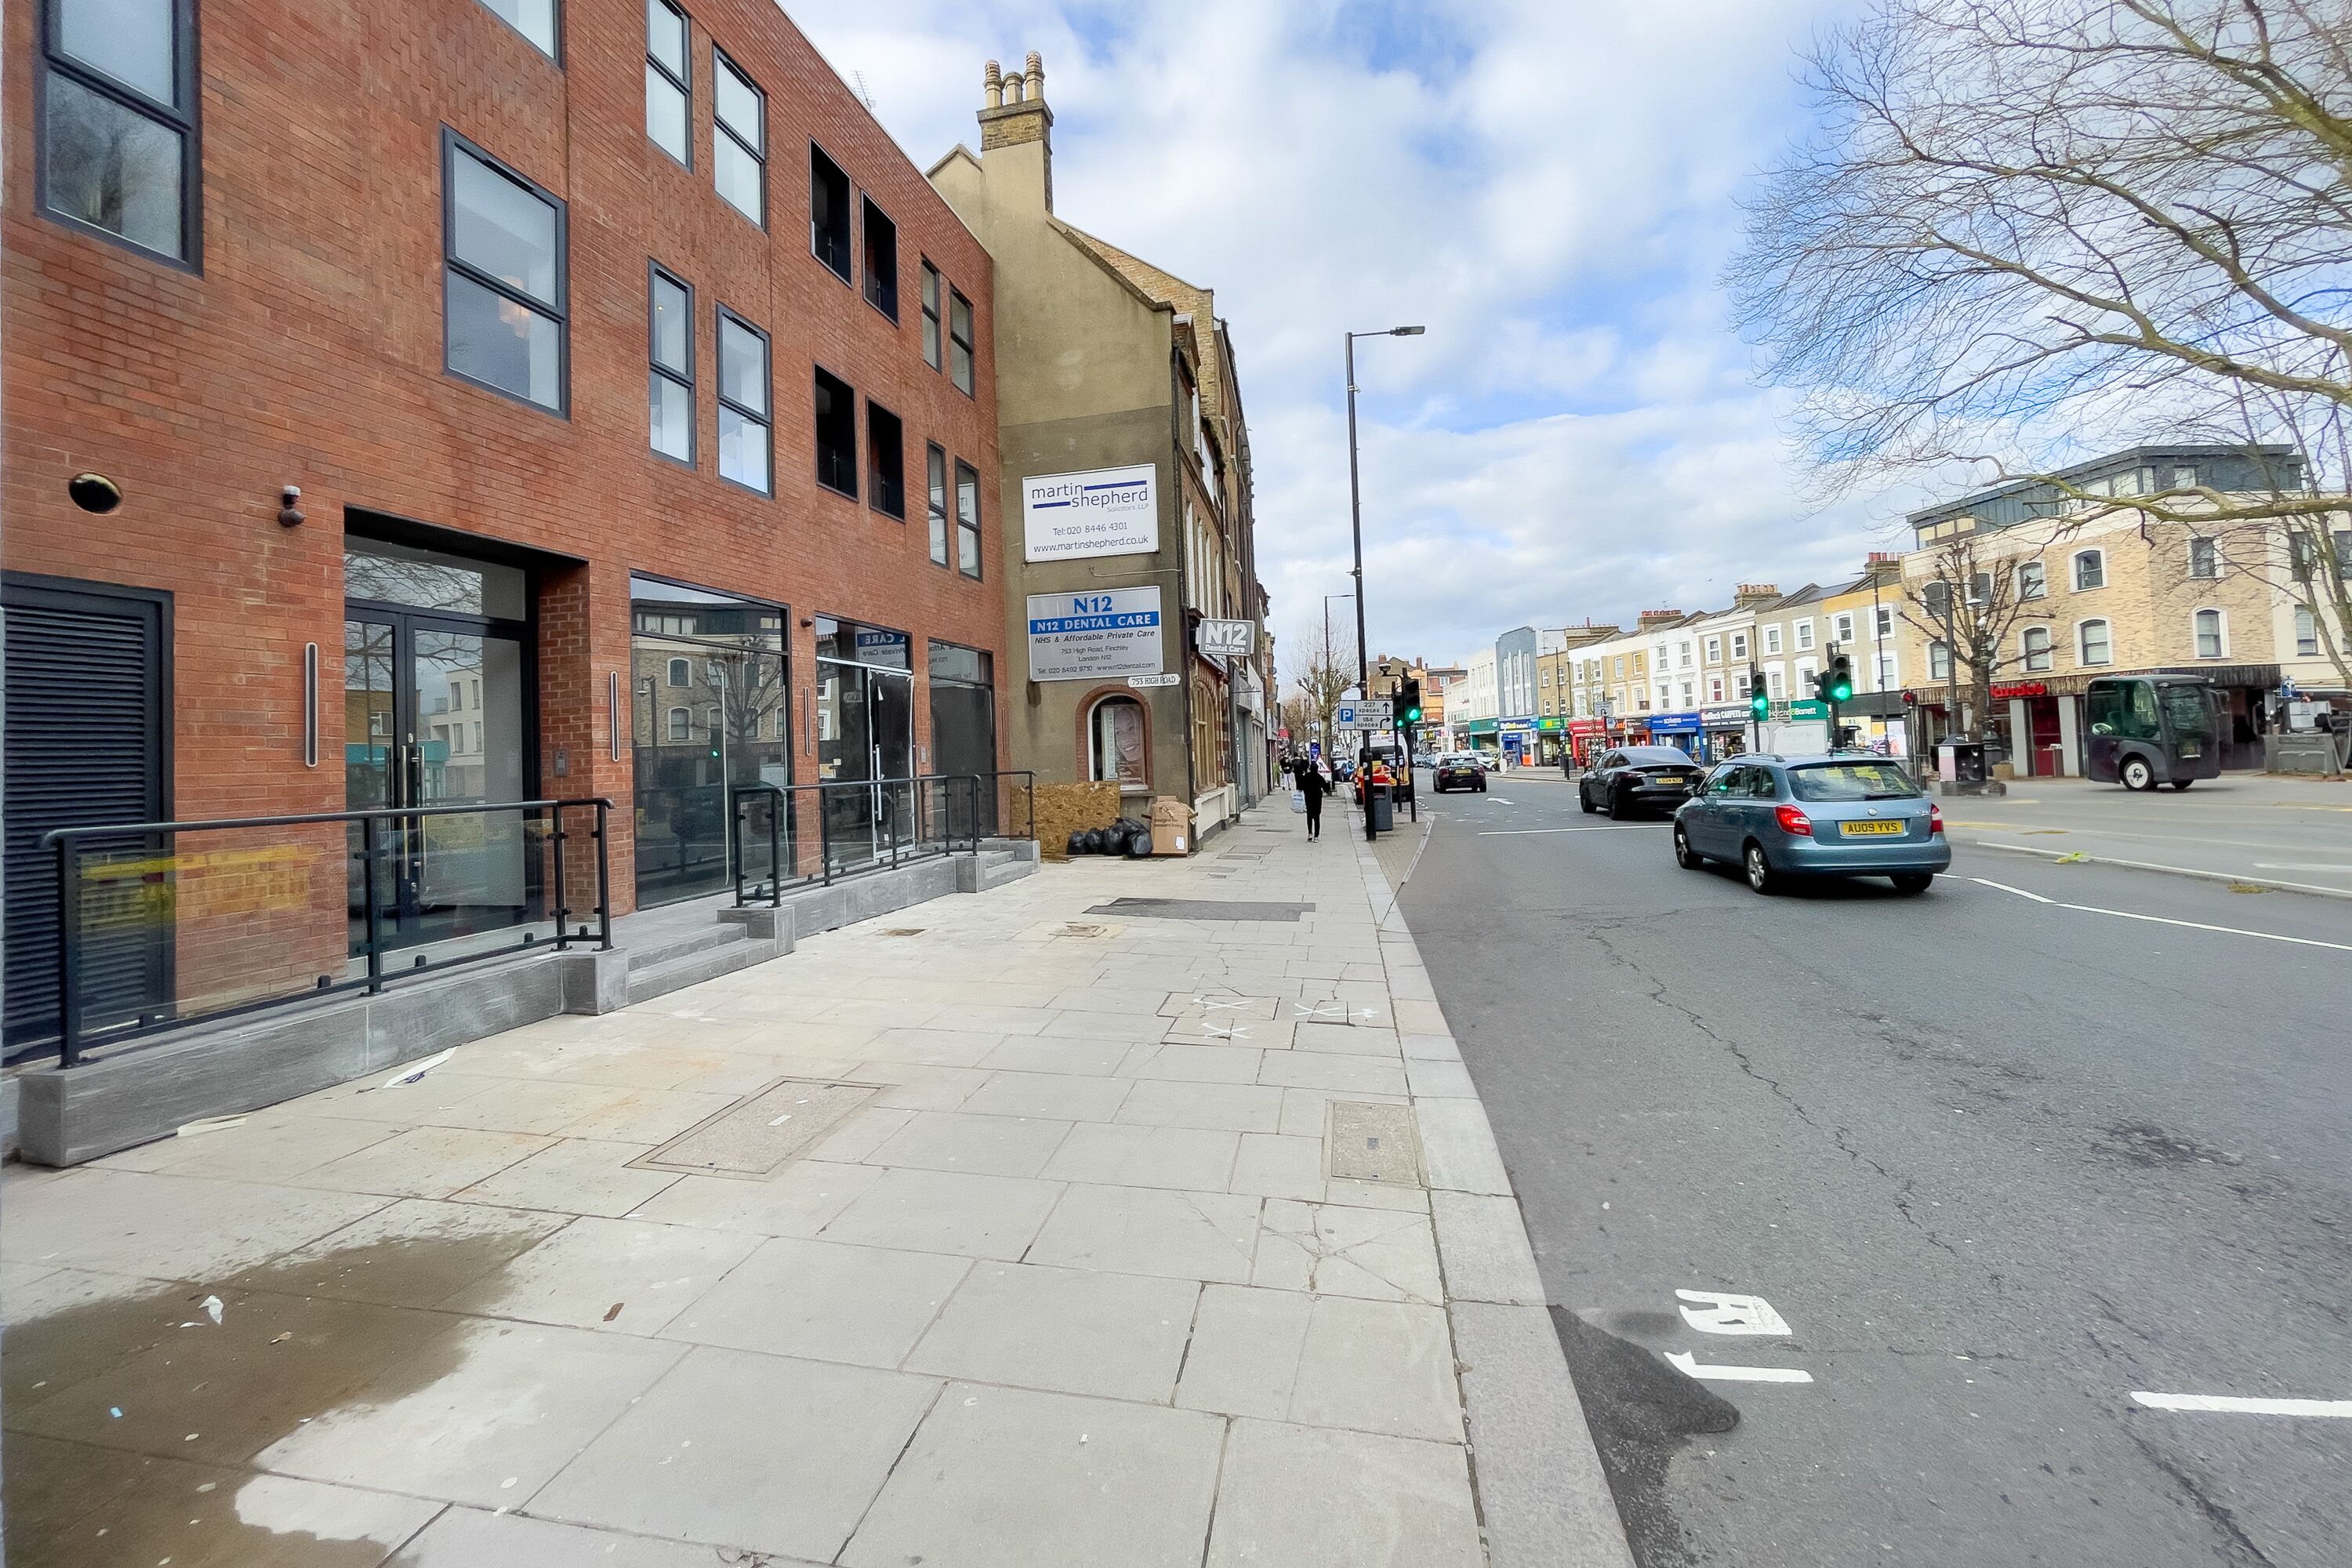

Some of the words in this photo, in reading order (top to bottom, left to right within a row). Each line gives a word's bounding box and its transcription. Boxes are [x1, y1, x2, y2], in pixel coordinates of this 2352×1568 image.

[1032, 482, 1083, 499] martin
[1072, 487, 1148, 508] shepherd
[1085, 524, 1106, 534] 8446
[1109, 521, 1127, 532] 4301
[1033, 535, 1149, 553] www.martinshepherd.co.uk
[1073, 595, 1113, 615] N12
[1036, 621, 1059, 632] N12
[1065, 617, 1112, 630] DENTAL
[1117, 614, 1151, 626] CARE
[1063, 633, 1104, 643] Affordable
[1107, 631, 1134, 640] Private
[1205, 622, 1247, 646] N12
[1204, 644, 1228, 652] Dental
[1342, 710, 1352, 721] P
[1848, 823, 1875, 833] AU09
[1875, 822, 1898, 832] YVS
